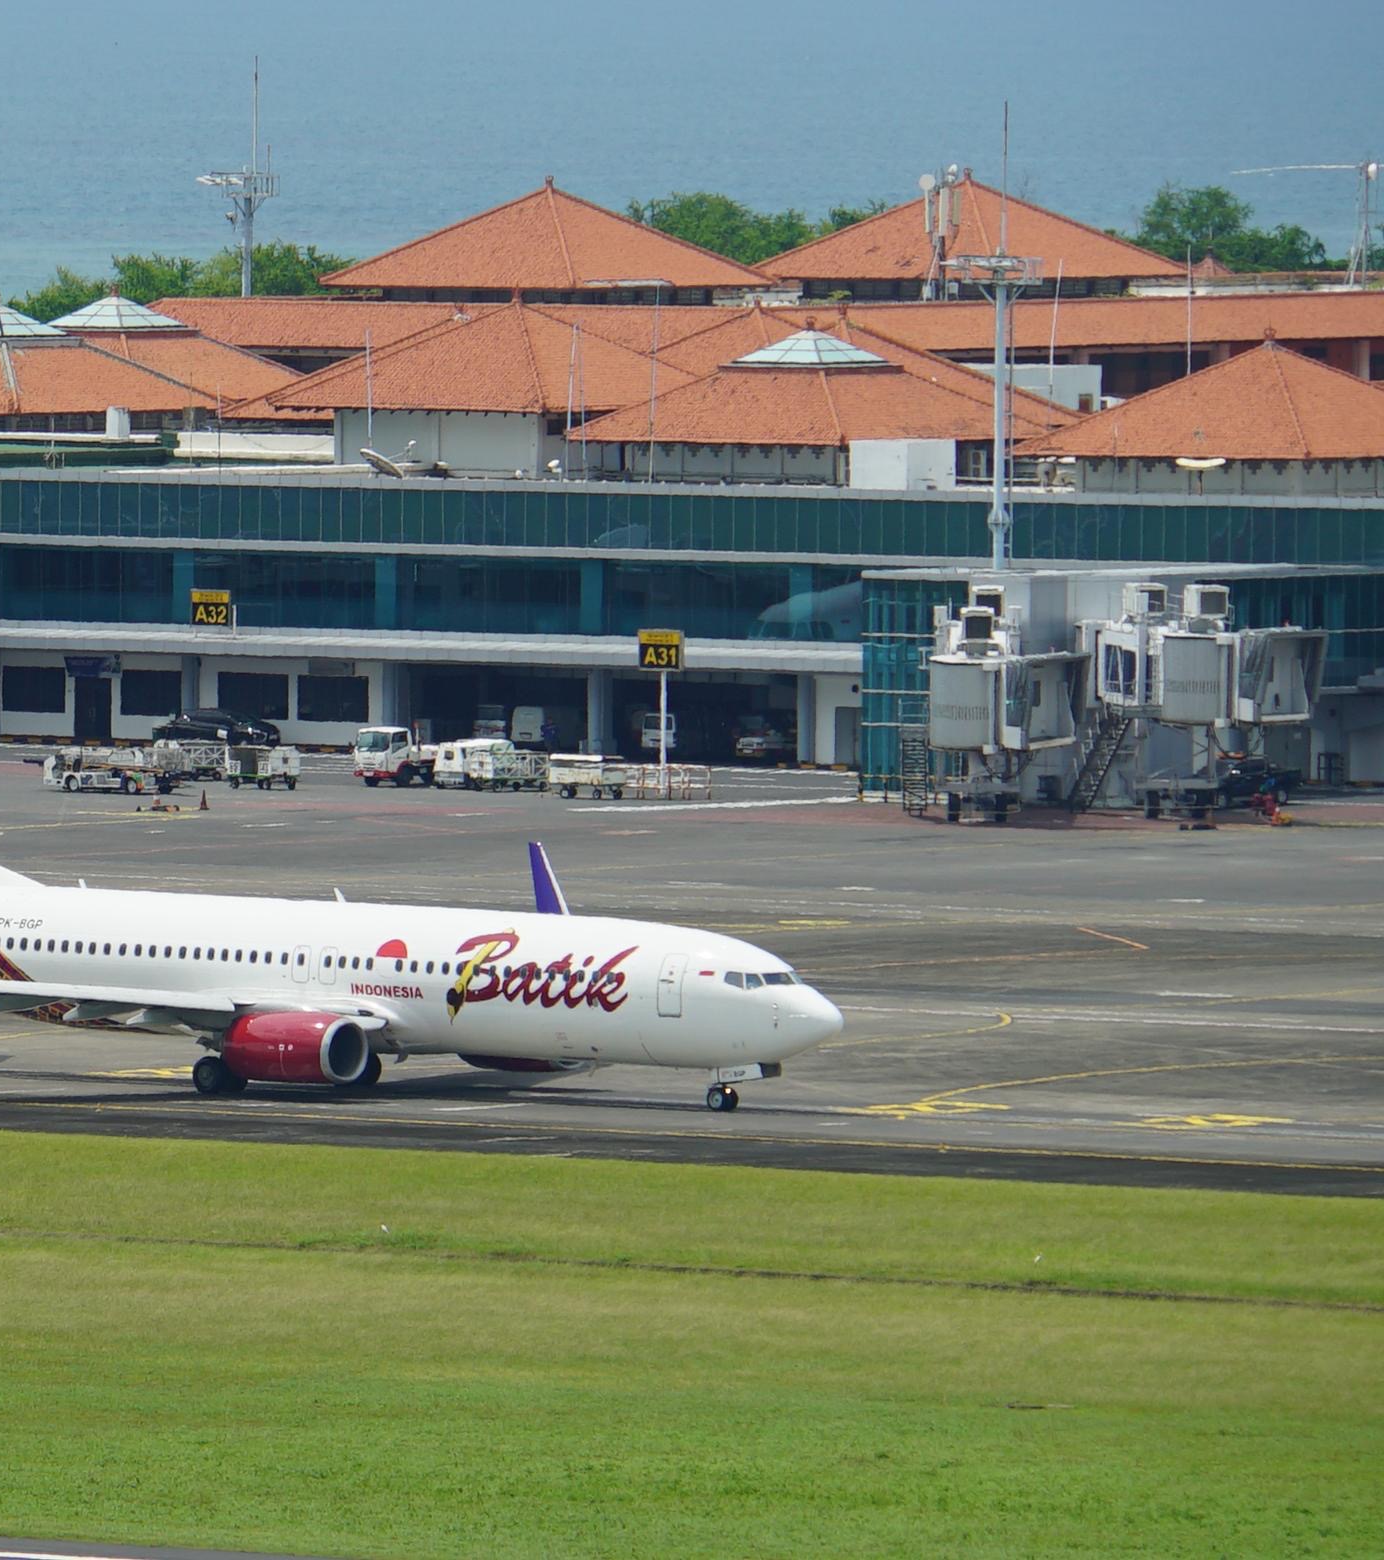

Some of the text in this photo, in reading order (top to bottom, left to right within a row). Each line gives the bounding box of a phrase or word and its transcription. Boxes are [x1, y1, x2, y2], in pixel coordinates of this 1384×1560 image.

[195, 604, 227, 624] A32
[644, 646, 676, 666] A31
[454, 930, 640, 1014] Batik
[350, 982, 424, 1000] INDONESIA
